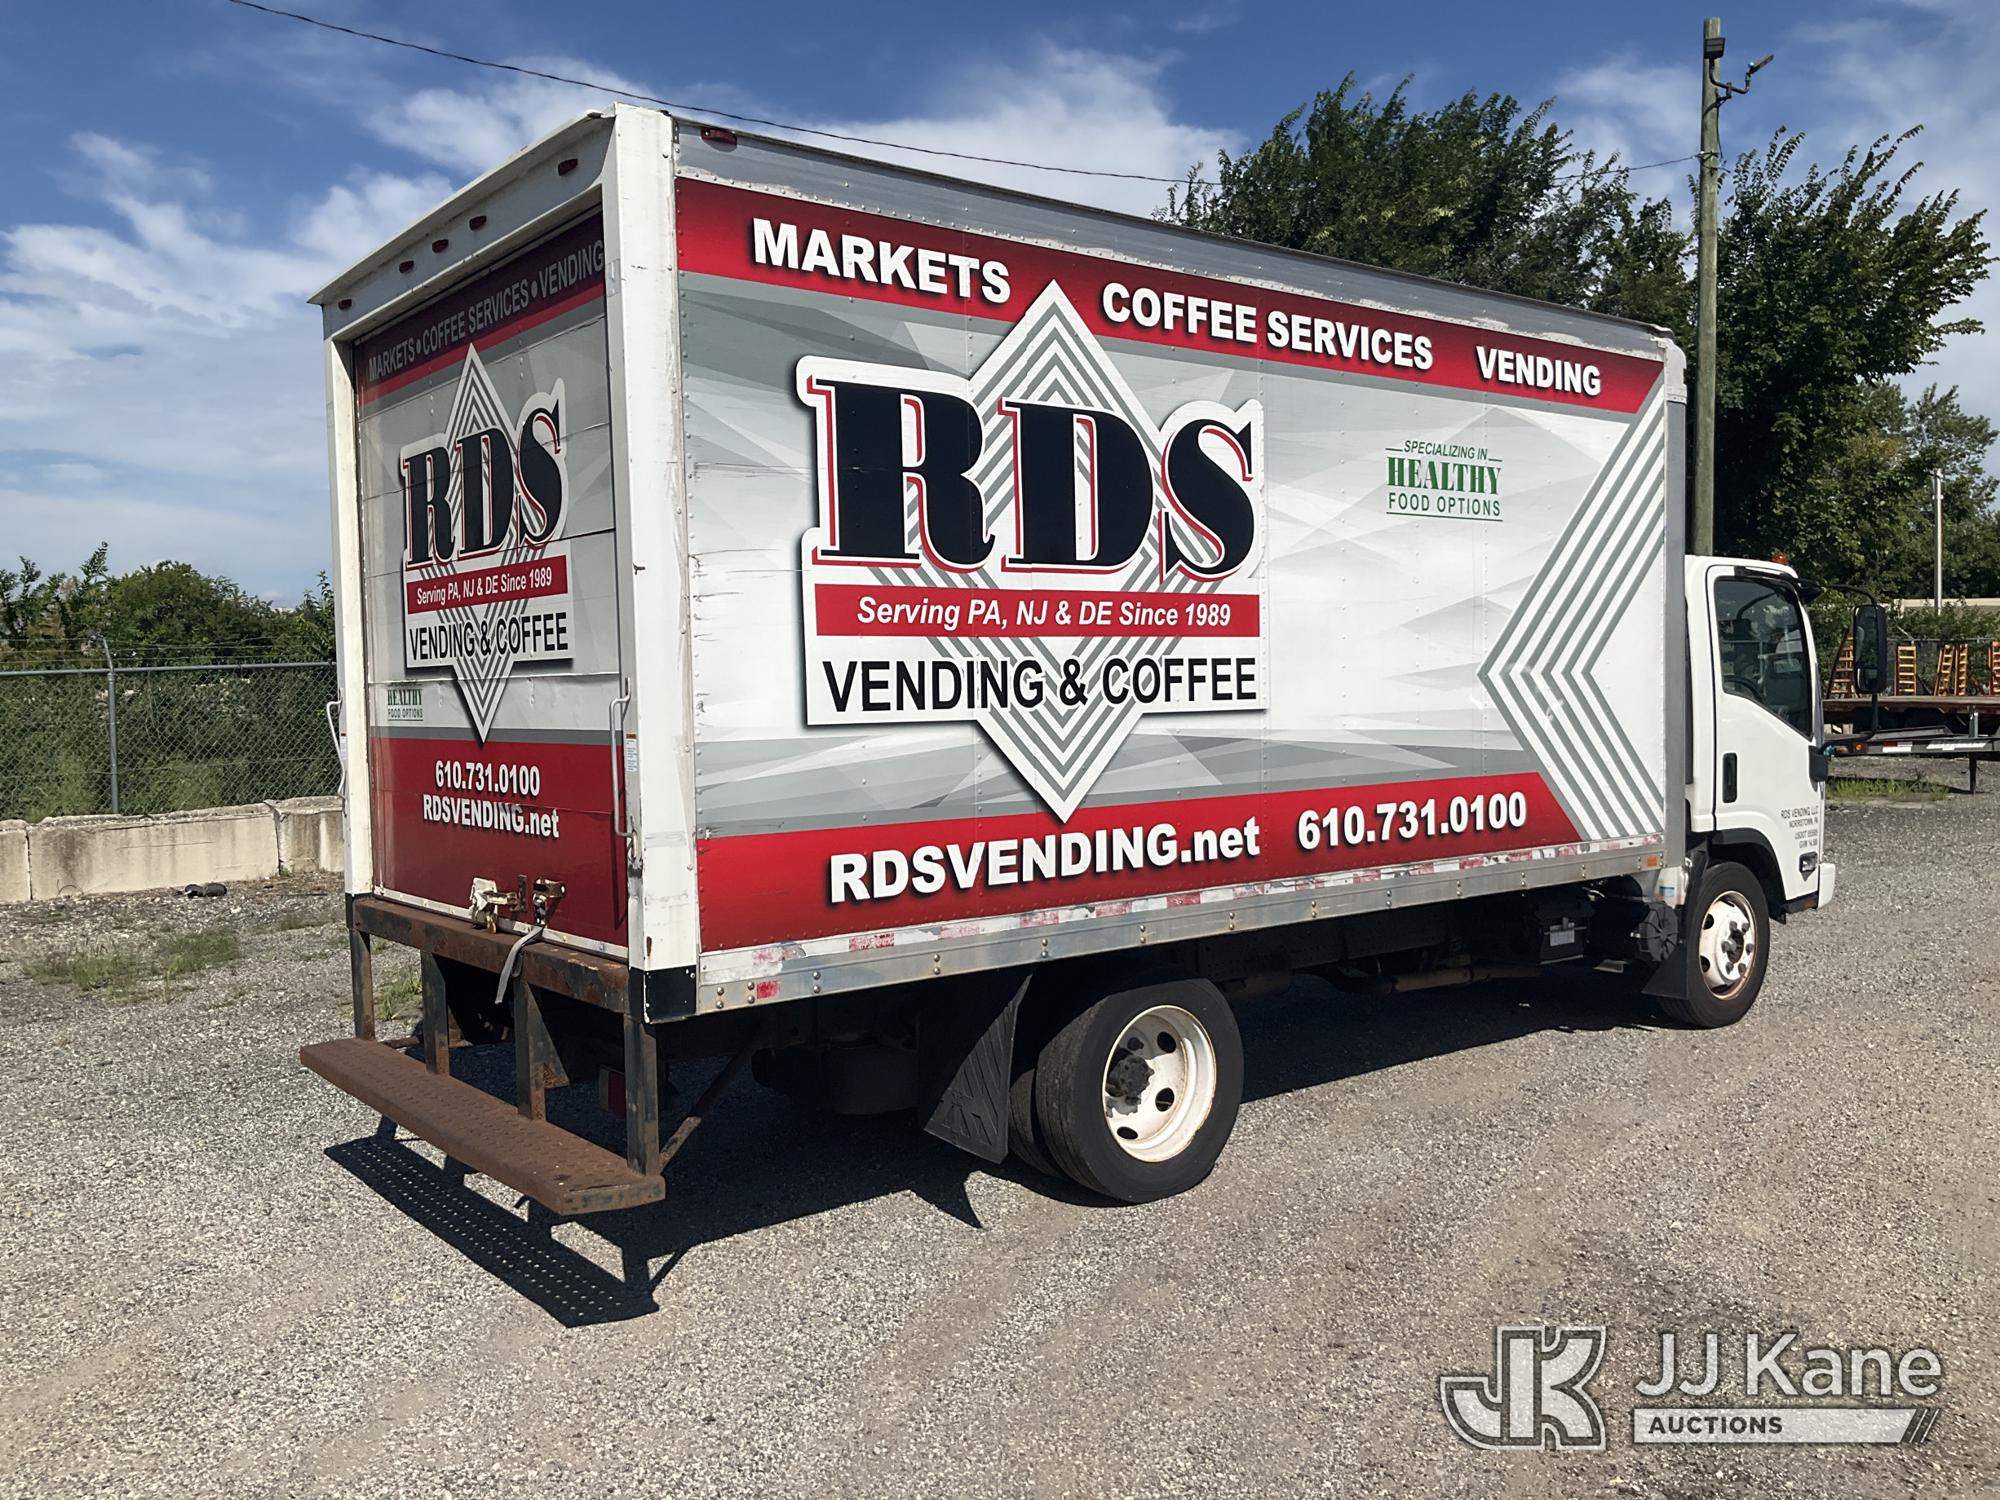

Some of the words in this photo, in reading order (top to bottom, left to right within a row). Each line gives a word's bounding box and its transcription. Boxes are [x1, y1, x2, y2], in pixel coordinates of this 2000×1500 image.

[368, 339, 416, 382] MARKETS
[422, 310, 466, 356] COFFEE
[467, 279, 529, 335] SERVICES
[538, 239, 604, 296] VENDING
[752, 218, 1011, 304] MARKETS
[1101, 282, 1257, 344] COFFEE
[1267, 310, 1433, 371] SERVICES
[1475, 346, 1601, 396] VENDING
[1404, 440, 1475, 459] SPECIALIZING
[1477, 448, 1488, 460] IN
[402, 400, 562, 571] RDS
[806, 374, 1255, 585] RDS
[1387, 456, 1501, 495] HEALTHY
[1388, 492, 1429, 511] FOOD
[1437, 496, 1500, 516] OPTIONS
[417, 585, 445, 606] Serving
[448, 583, 461, 601] PA,
[463, 582, 475, 597] NJ
[477, 582, 484, 596] &
[485, 576, 498, 594] DE
[500, 573, 527, 593] Since
[529, 567, 552, 589] 1989
[410, 622, 475, 660] VENDING
[480, 620, 491, 656] &
[496, 612, 568, 654] COFFEE
[857, 596, 960, 628] Serving
[967, 600, 1007, 629] PA,
[1016, 601, 1048, 626] NJ
[1055, 601, 1072, 625] &
[1079, 602, 1112, 626] DE
[1119, 602, 1178, 626] Since
[1185, 604, 1232, 627] 1989
[822, 659, 1045, 713] VENDING
[1059, 658, 1088, 705] &
[1102, 657, 1257, 703] COFFEE
[435, 760, 541, 797] 610.731.0100
[423, 794, 560, 838] RDSVENDING.net
[1298, 791, 1527, 850] 610.731.0100
[830, 816, 1261, 903] RDSVENDING.net
